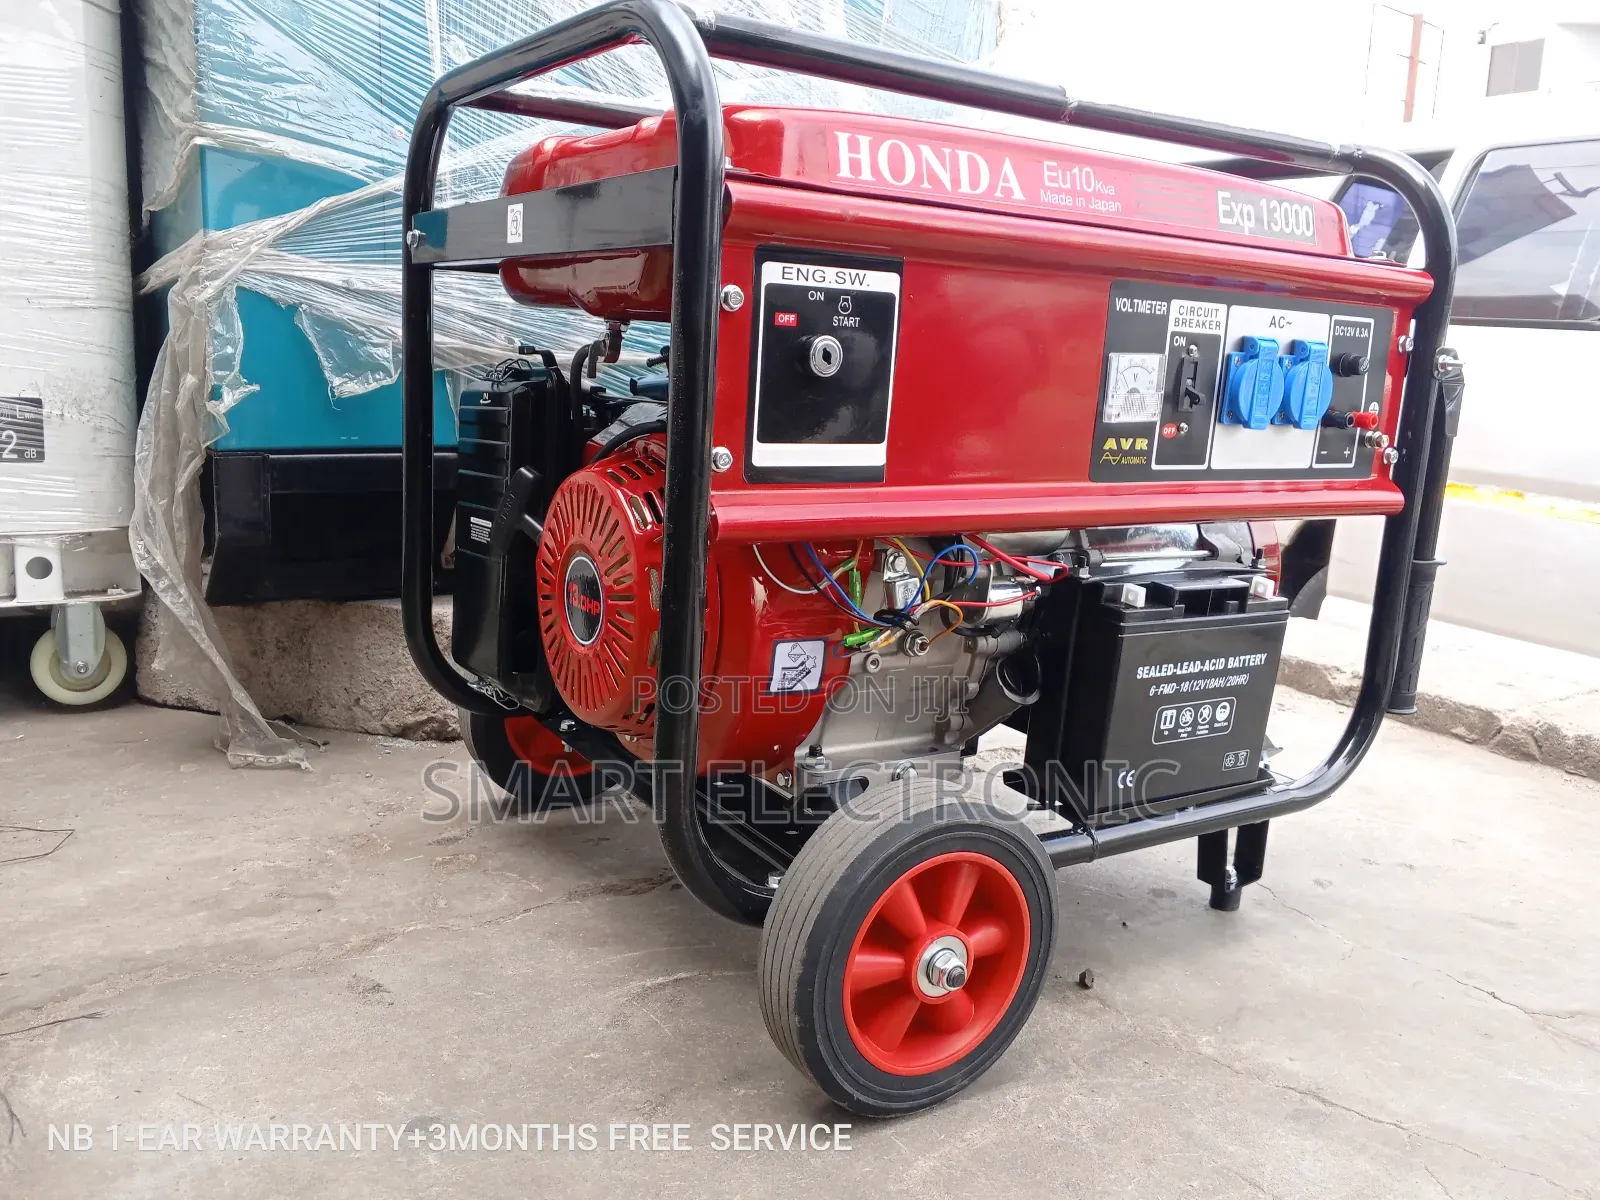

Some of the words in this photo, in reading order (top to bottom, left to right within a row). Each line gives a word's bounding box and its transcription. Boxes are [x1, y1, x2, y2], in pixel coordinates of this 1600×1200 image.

[833, 131, 1026, 201] HONDA
[1040, 189, 1072, 208] Made
[1075, 193, 1086, 208] in
[1088, 196, 1122, 214] Japan
[1218, 190, 1254, 235] Exp
[1261, 198, 1315, 238] 13000
[782, 266, 871, 287] ENG.SW.
[808, 290, 825, 301] ON
[1115, 297, 1168, 315] VOLTMETER
[1178, 304, 1220, 318] CIRCUIT
[778, 314, 795, 324] OFF
[832, 316, 860, 328] START
[1174, 317, 1222, 331] BREAKER
[1335, 325, 1355, 337] DC12V
[1173, 335, 1186, 347] ON
[1163, 426, 1176, 435] OFF
[1103, 437, 1148, 450] AVR
[24, 448, 37, 458] dB
[1121, 456, 1147, 465] AUTOMATIC
[1136, 658, 1226, 679] SEALED-LEAD-ACID
[1227, 653, 1268, 668] BATTERY
